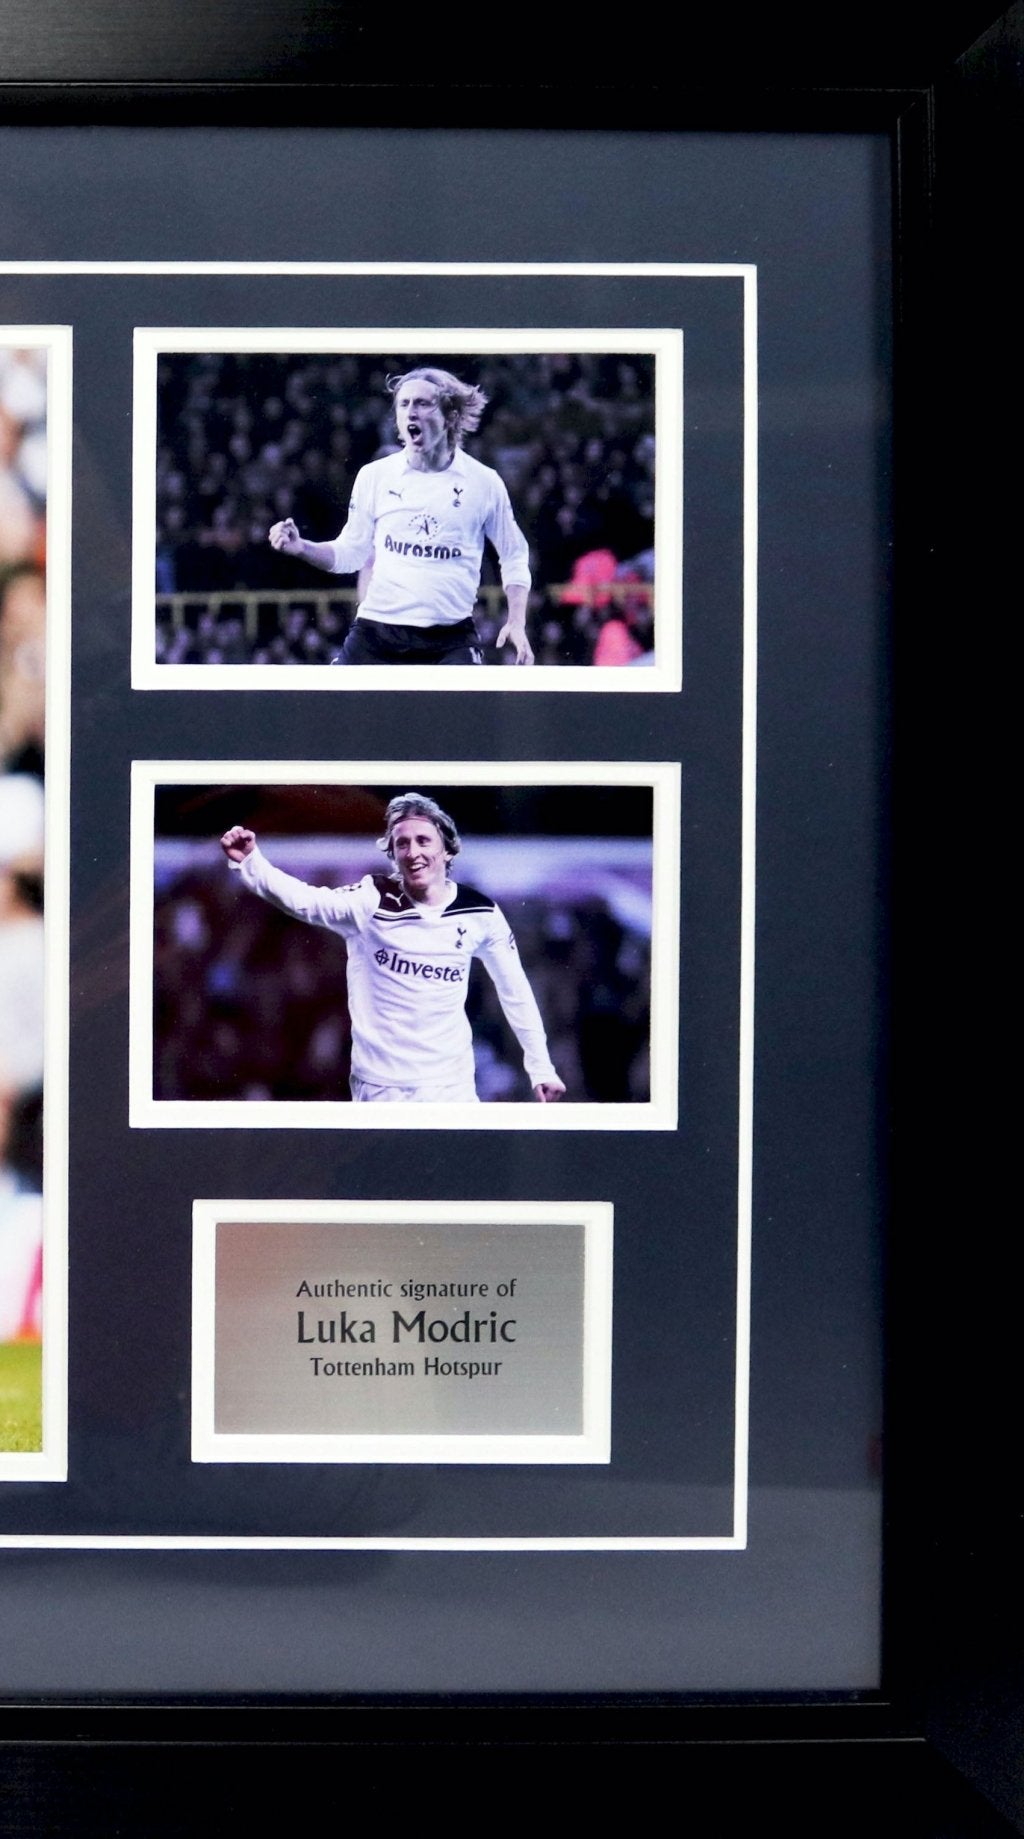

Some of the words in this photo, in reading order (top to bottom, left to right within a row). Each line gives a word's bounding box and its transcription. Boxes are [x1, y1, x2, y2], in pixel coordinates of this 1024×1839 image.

[384, 534, 462, 560] Aurasma
[296, 1279, 393, 1298] Authentic
[400, 1279, 489, 1301] signature
[496, 1278, 517, 1298] of
[297, 1310, 376, 1344] Luka
[392, 1310, 517, 1344] Modric
[309, 1357, 415, 1377] Tottenham
[424, 1357, 502, 1379] Hotspur
